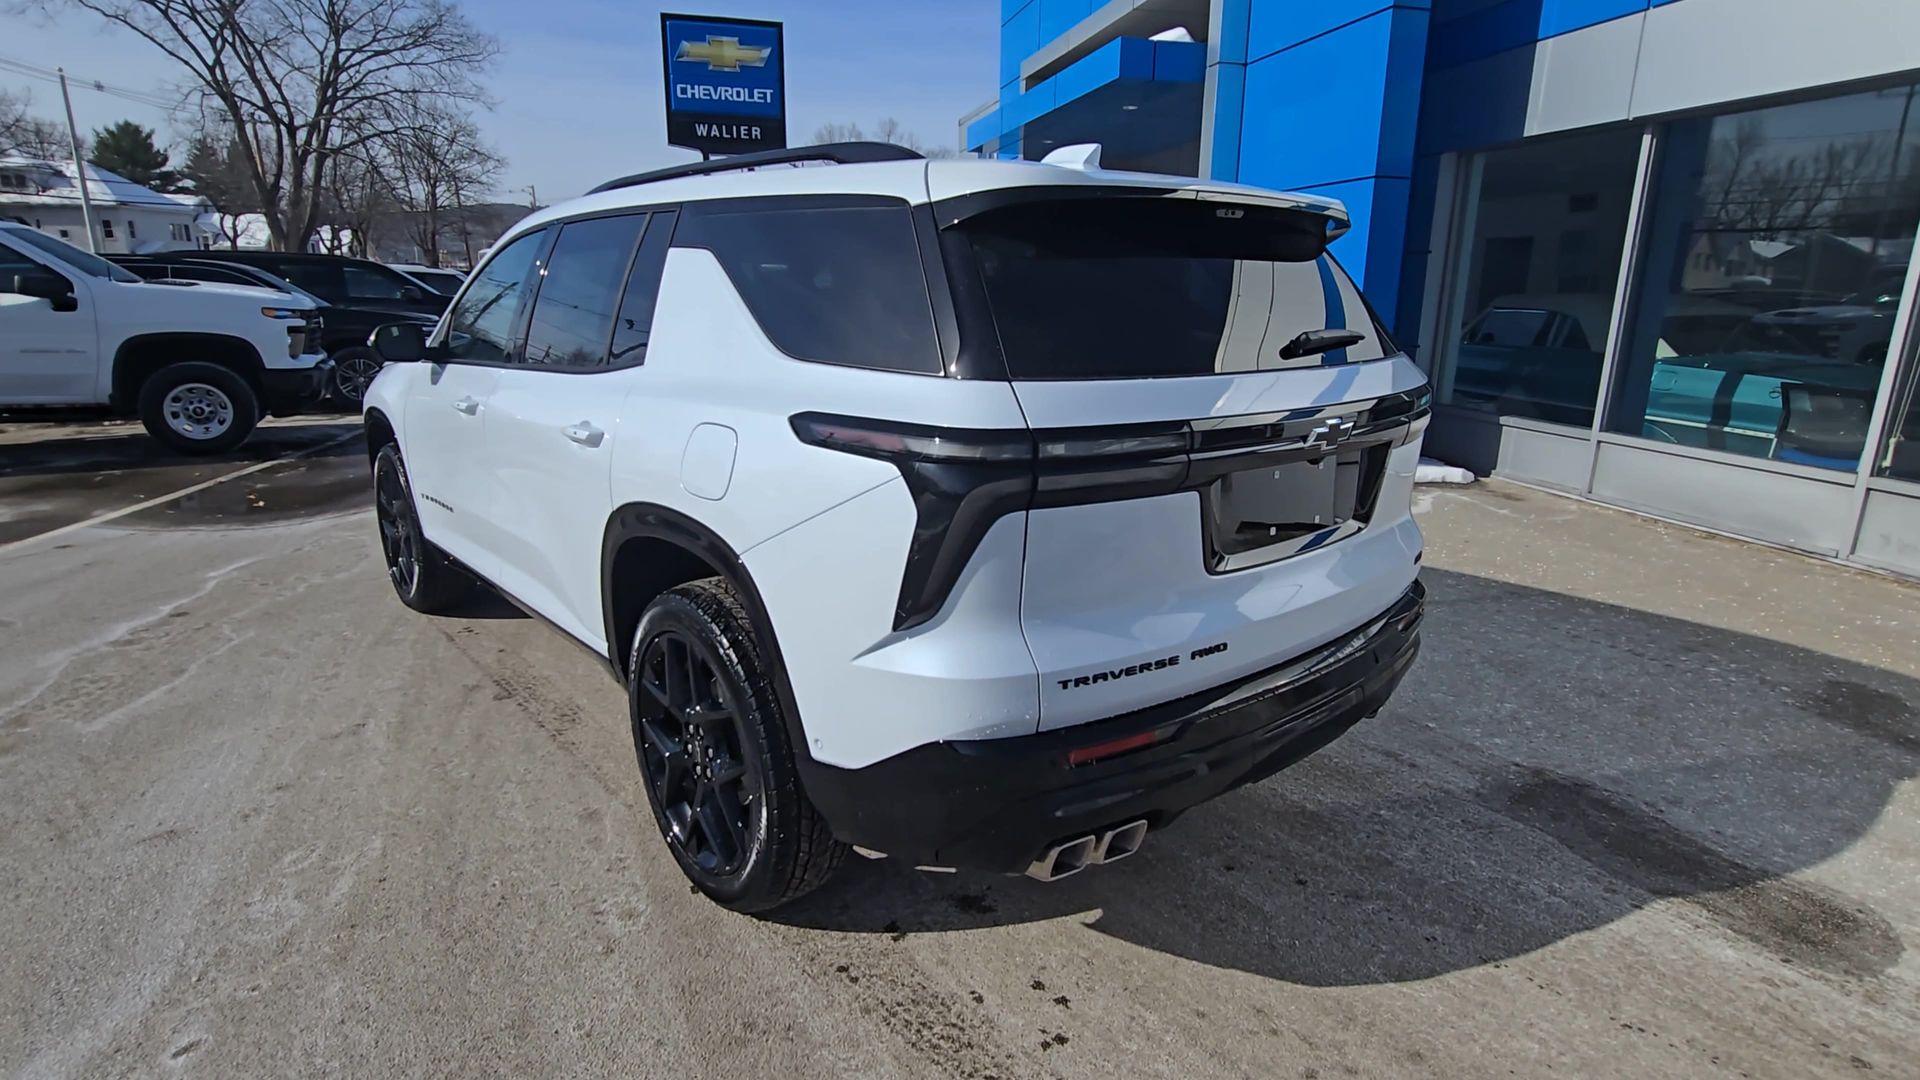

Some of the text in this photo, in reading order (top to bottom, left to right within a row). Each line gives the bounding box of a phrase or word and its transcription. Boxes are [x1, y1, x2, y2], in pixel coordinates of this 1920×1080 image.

[676, 84, 774, 103] CHEVROLET
[695, 123, 762, 140] WALIER
[1057, 642, 1228, 690] TRAVERSE AWD
